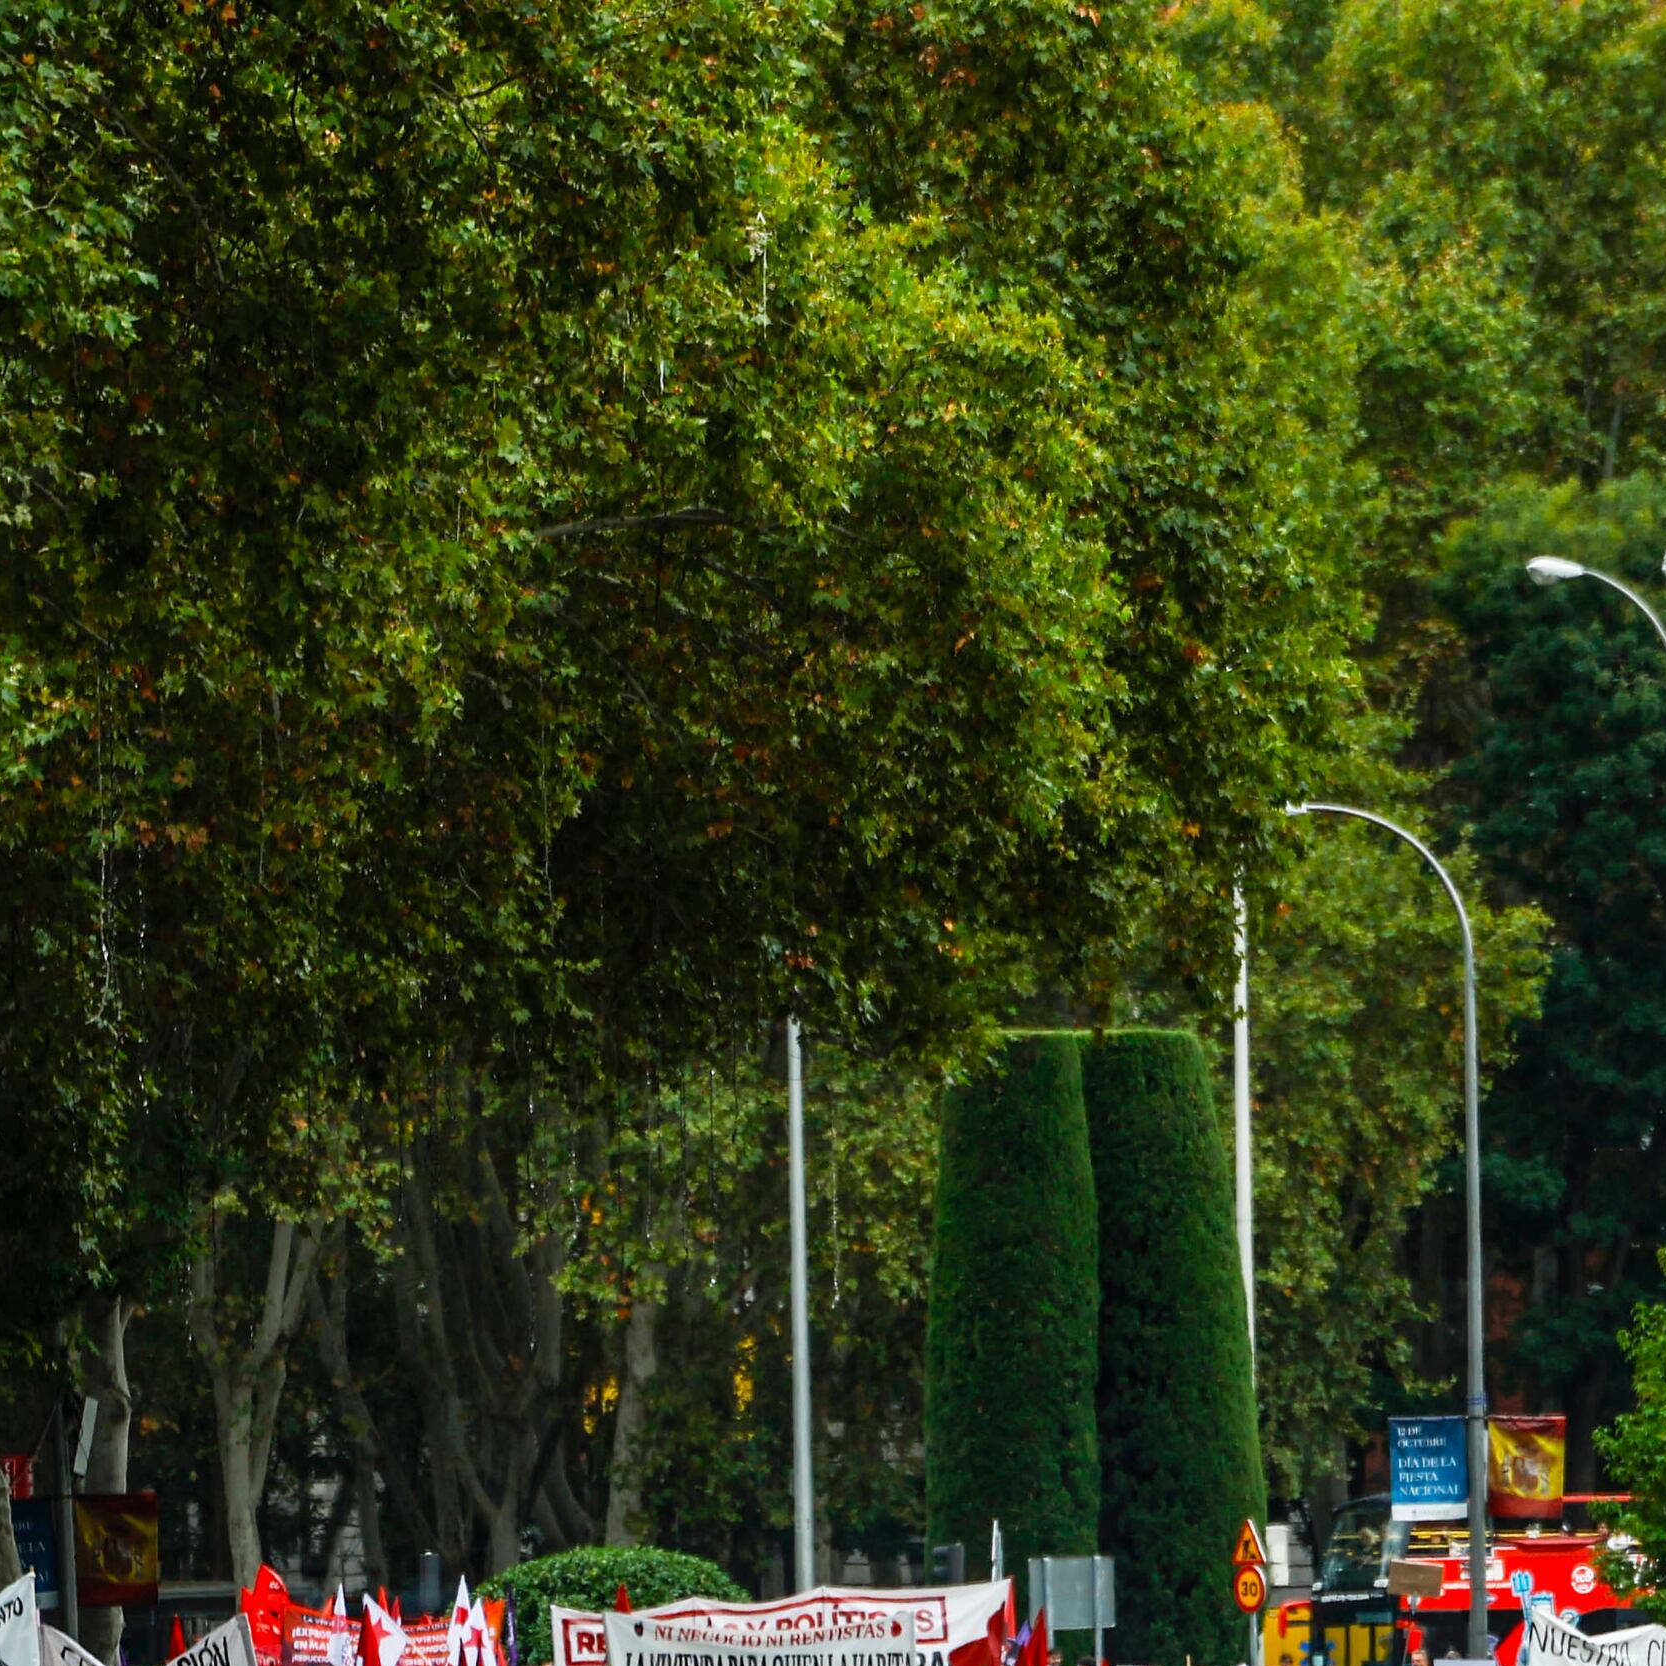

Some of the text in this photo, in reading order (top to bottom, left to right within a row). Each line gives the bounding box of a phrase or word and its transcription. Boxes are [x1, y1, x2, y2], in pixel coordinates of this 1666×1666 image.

[1397, 1437, 1447, 1449] OCTUBRE
[1398, 1455, 1457, 1469] DÍA DE LA
[1398, 1471, 1439, 1483] FIESTA
[1398, 1483, 1463, 1497] NACIONAL
[1240, 1581, 1259, 1598] 30
[655, 1625, 673, 1641] NI
[766, 1630, 784, 1647] NI
[785, 1623, 887, 1647] RENTISTAS
